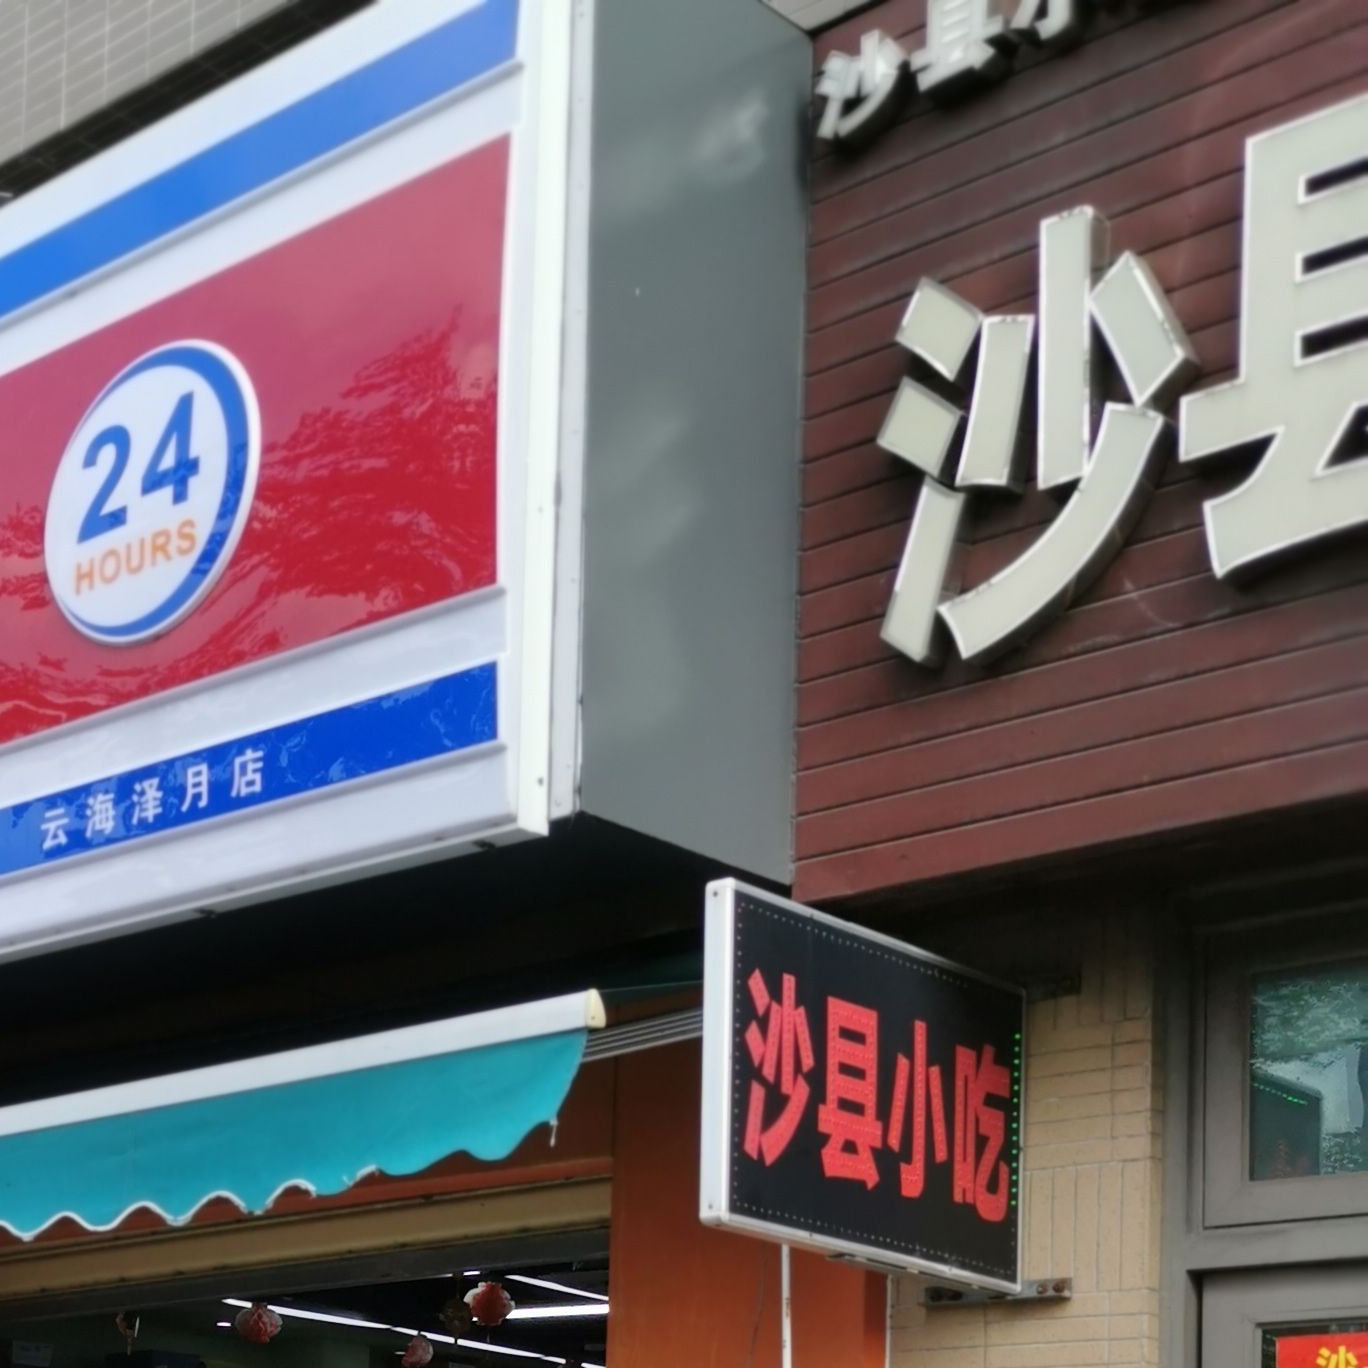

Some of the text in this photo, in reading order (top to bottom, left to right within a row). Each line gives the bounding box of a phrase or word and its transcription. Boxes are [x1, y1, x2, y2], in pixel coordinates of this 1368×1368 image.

[816, 0, 1073, 138] 沙县
[77, 391, 200, 544] 24
[75, 519, 198, 596] HOURS
[40, 749, 264, 852] 云海泽月店
[744, 967, 1010, 1222] 沙县小吃
